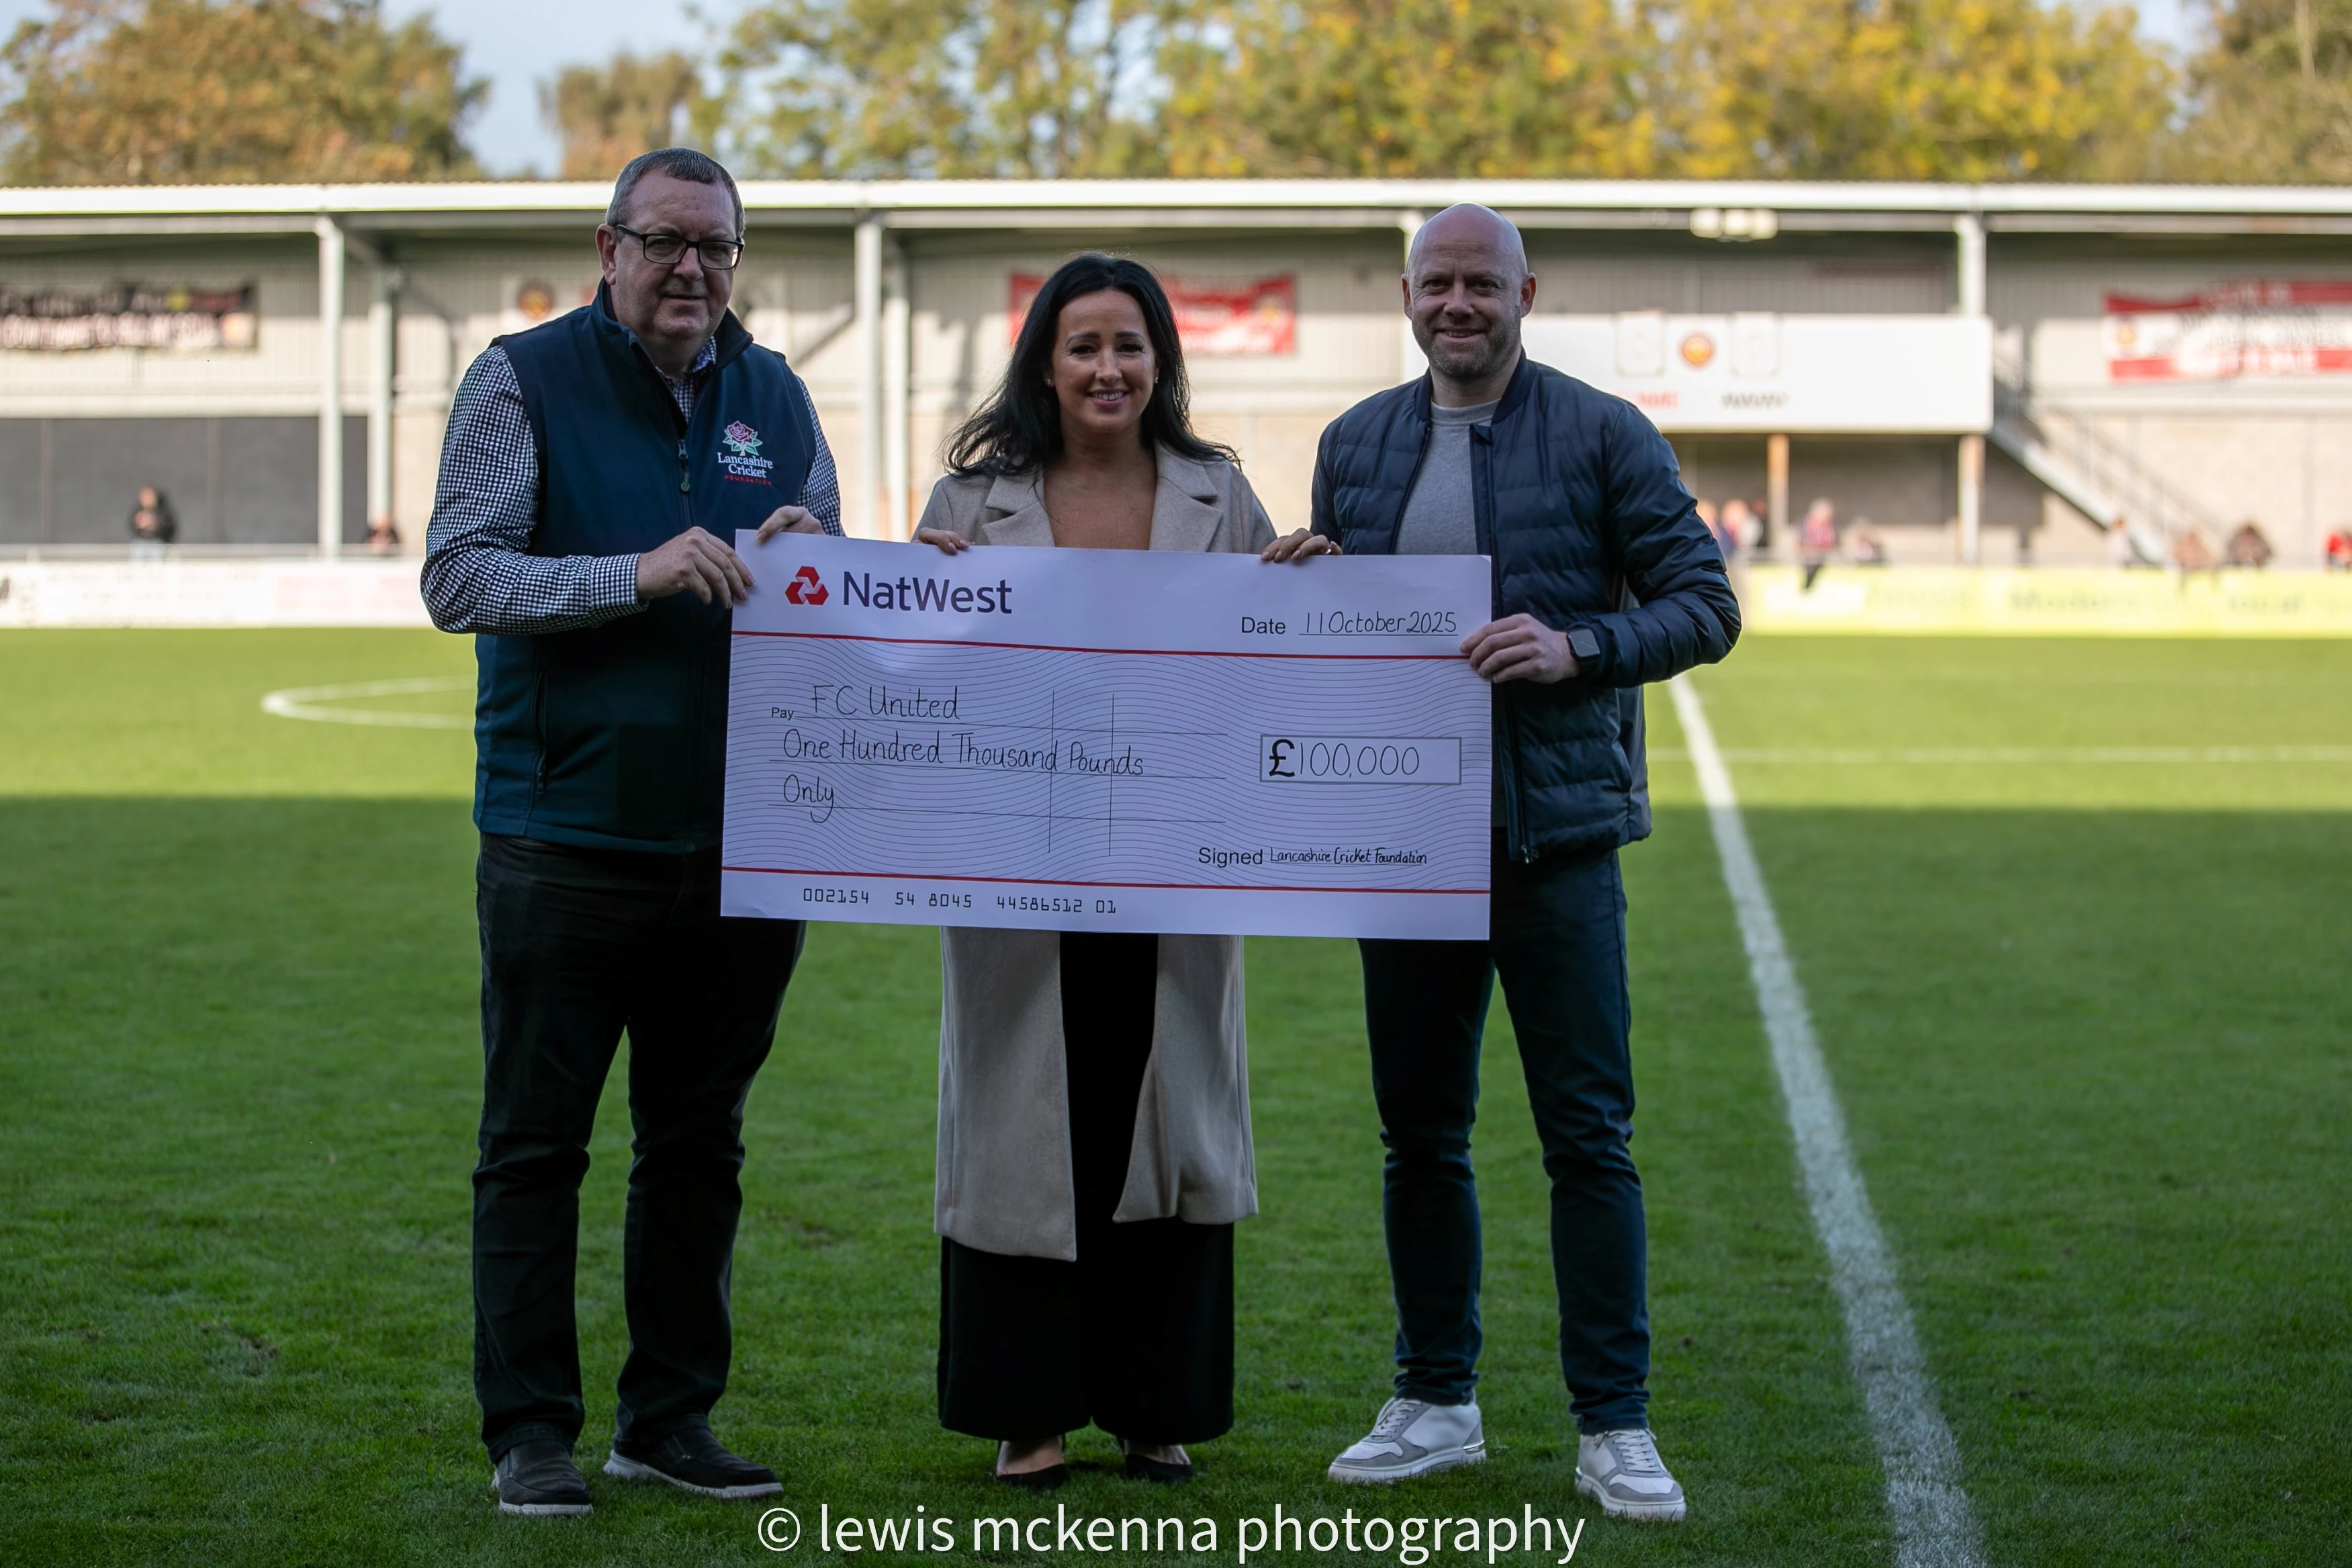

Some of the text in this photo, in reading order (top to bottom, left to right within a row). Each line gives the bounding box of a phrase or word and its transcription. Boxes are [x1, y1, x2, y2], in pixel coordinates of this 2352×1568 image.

[717, 452, 774, 469] Lancashire
[728, 463, 767, 478] Cricket
[843, 570, 1013, 614] NatWest
[1240, 616, 1286, 635] Date
[1328, 610, 1406, 633] October
[1406, 610, 1457, 633] 2025
[770, 684, 961, 721] Pay FC United
[783, 729, 1144, 776] One Hundred Thousand Pounds
[783, 774, 835, 824] Only
[1198, 847, 1428, 868] Signed Lancashire Cricket Foundation
[803, 888, 1117, 915] 002154 54 8045 44586512 01
